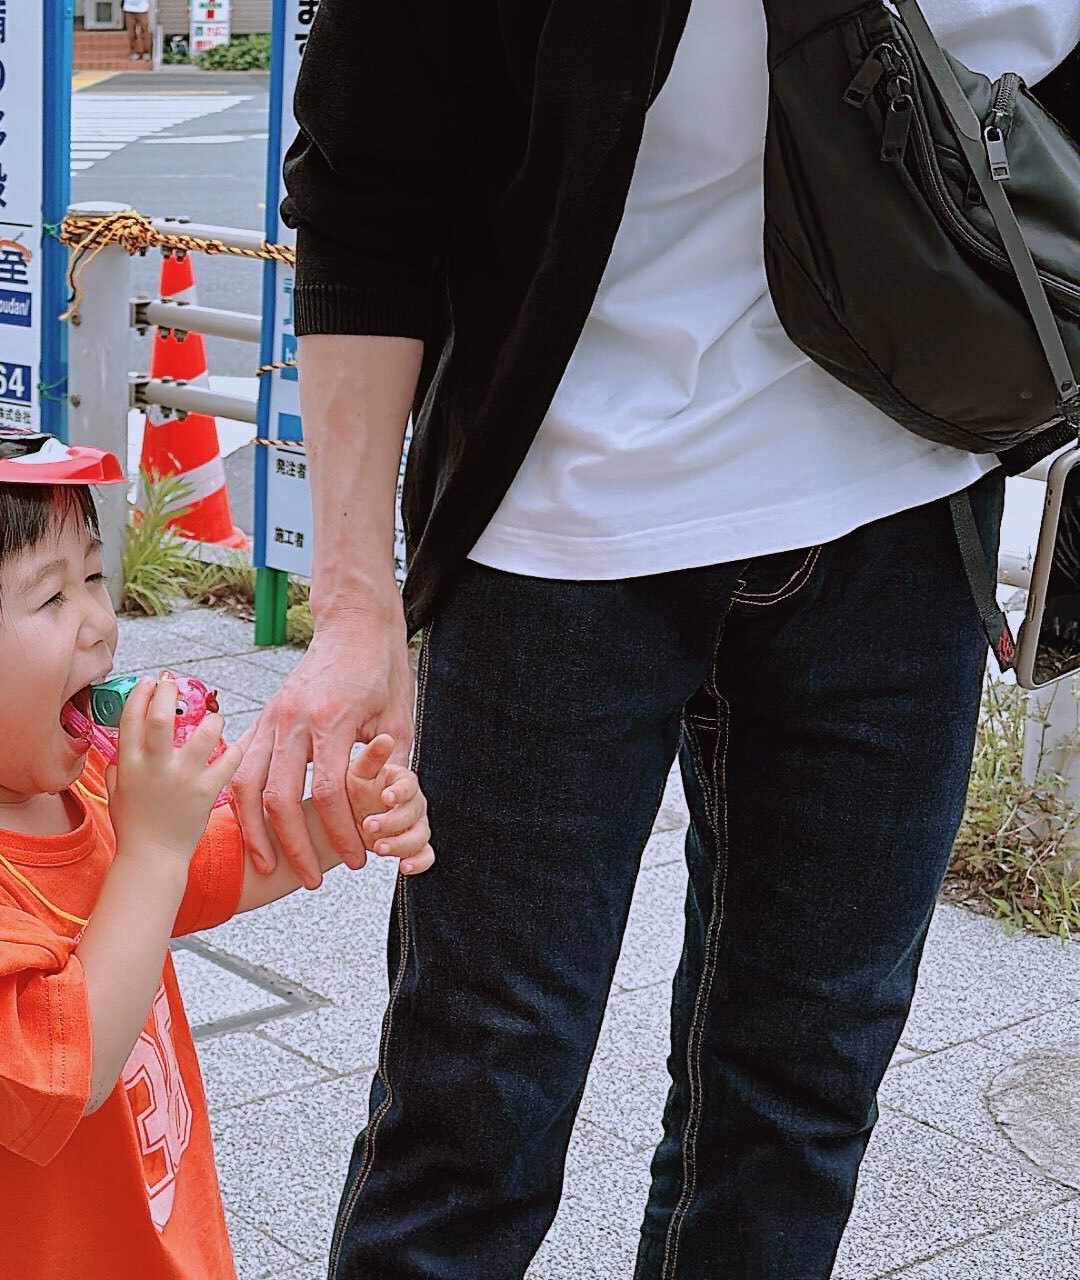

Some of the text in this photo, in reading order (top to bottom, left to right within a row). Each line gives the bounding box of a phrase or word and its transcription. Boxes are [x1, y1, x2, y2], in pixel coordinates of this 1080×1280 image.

[275, 458, 306, 480] 発注者
[274, 526, 305, 549] 施工者
